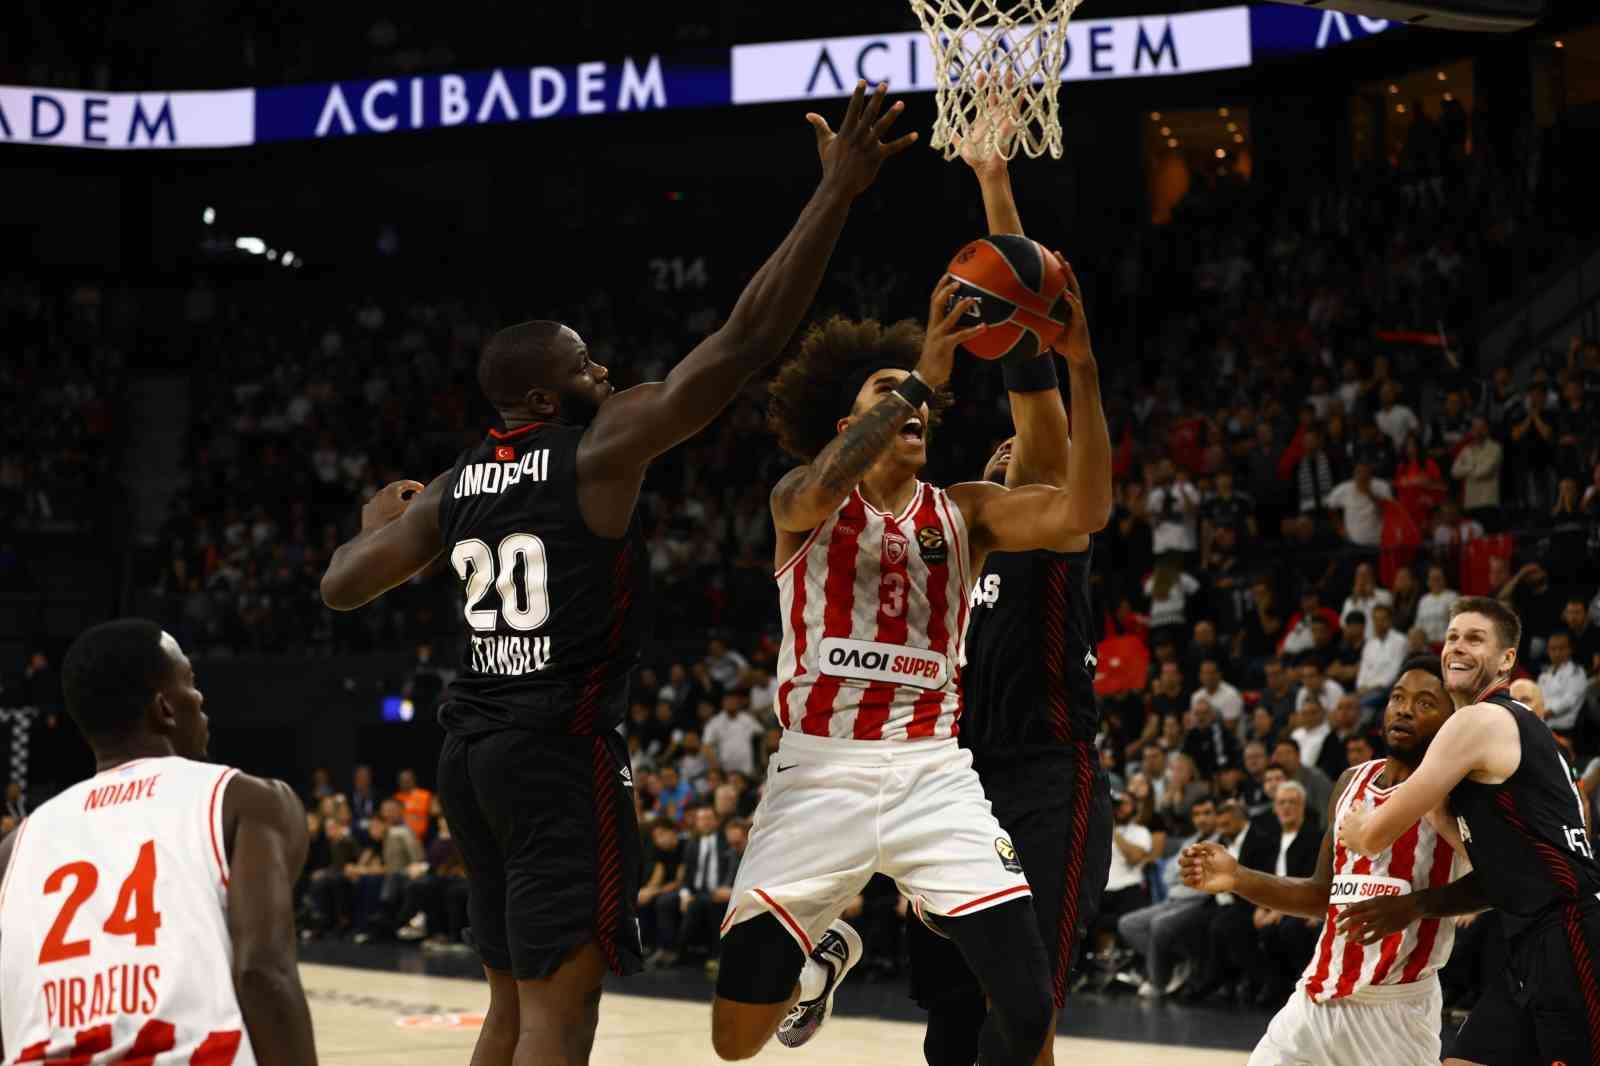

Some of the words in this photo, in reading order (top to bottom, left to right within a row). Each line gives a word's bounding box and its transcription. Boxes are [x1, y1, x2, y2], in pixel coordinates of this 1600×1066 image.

[315, 54, 667, 137] ACIBADEM
[451, 533, 550, 631] 20
[881, 572, 905, 617] 3
[891, 655, 940, 680] SUPER
[84, 774, 160, 812] NDIAYE
[38, 839, 162, 965] 24
[43, 963, 160, 1028] PIRAEUS
